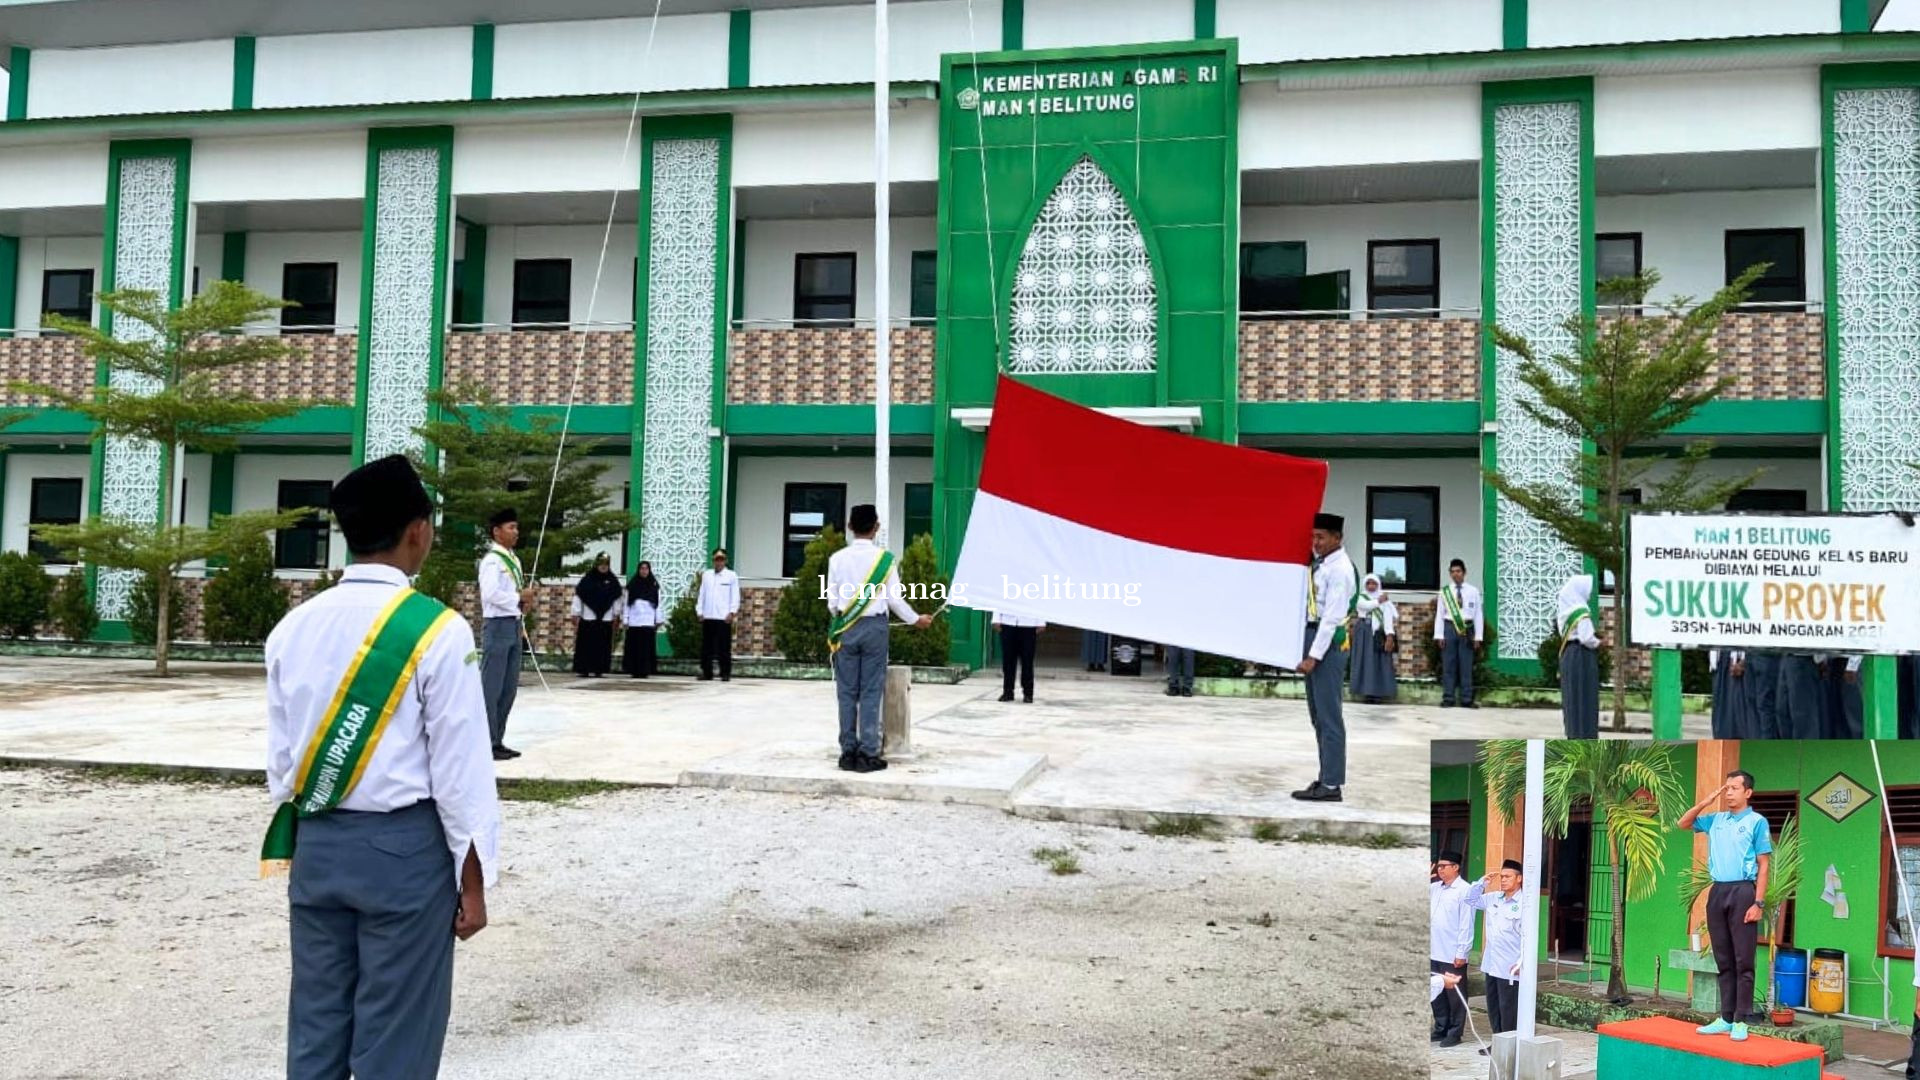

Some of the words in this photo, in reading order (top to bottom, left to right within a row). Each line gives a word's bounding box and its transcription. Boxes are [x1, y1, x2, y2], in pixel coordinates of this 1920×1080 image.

[983, 71, 1114, 92] KEMENTERIAN
[1122, 67, 1189, 87] AGAMA
[1198, 65, 1218, 82] RI
[982, 99, 1023, 116] MAN
[1027, 99, 1036, 114] 1
[1040, 93, 1135, 113] BELITUNG
[1694, 527, 1730, 545] MAN
[1734, 527, 1743, 545] 1
[1747, 527, 1832, 545] BELITUNG
[1644, 547, 1748, 561] PEMBANGUNAN
[1753, 549, 1811, 562] GEDUNG
[1818, 550, 1864, 563] KELAS
[1869, 550, 1908, 564] BARU
[1704, 563, 1759, 576] DIBIAYAI
[1644, 580, 1750, 619] SUKUK
[1762, 582, 1887, 622] PROYEK
[1769, 623, 1844, 637] ANGGARAN
[325, 703, 370, 766] UPACARA
